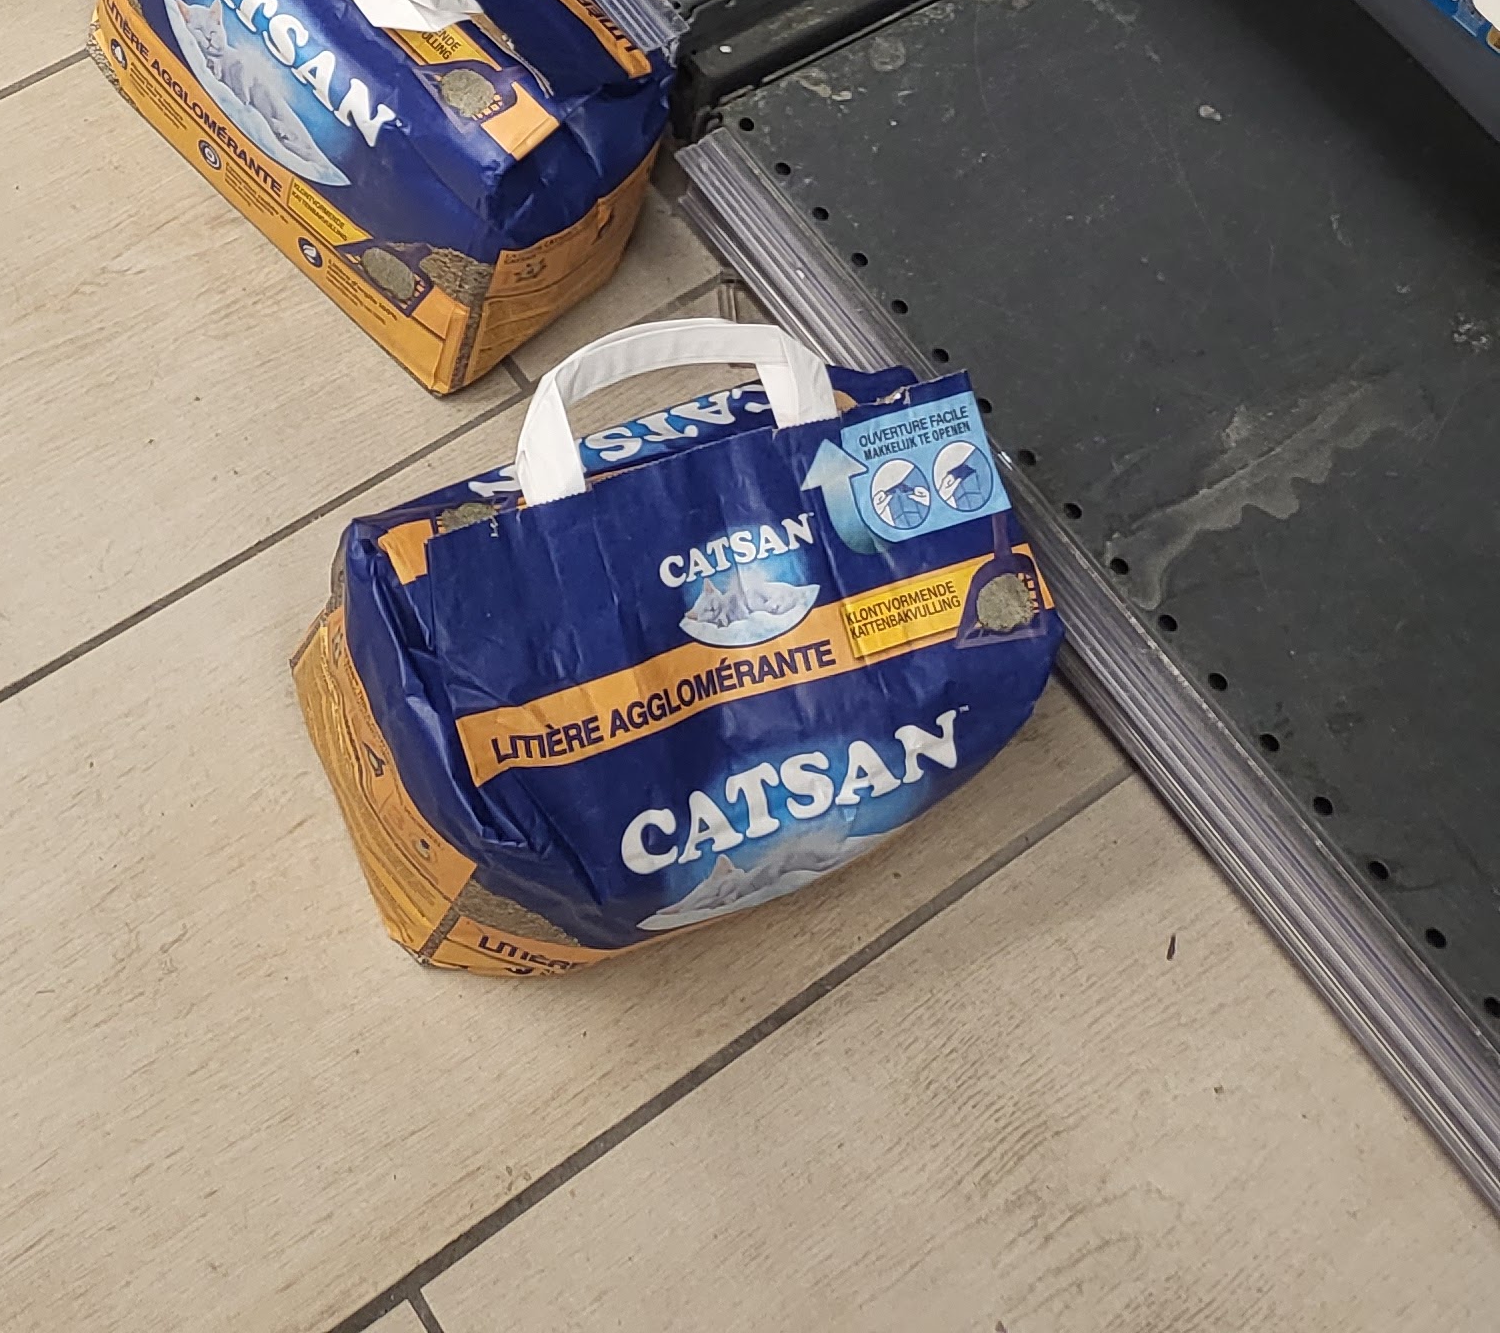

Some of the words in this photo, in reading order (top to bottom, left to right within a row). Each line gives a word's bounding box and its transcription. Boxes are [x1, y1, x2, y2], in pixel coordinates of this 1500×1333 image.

[150, 59, 283, 199] AGGLOMÉRANTE
[858, 416, 928, 449] OUVERTURE
[928, 405, 970, 430] FACILE
[863, 439, 918, 462] MAKKELIJK
[920, 434, 932, 446] TE
[932, 420, 971, 442] OPENEN
[658, 513, 813, 590] CATSAN
[846, 580, 956, 626] KLONTVORMENDE
[849, 595, 961, 640] KATTENBAKVULLING
[491, 717, 605, 764] LITIÈRE
[608, 639, 837, 739] AGGLOMÉRANTE
[620, 708, 960, 876] CATSAN
